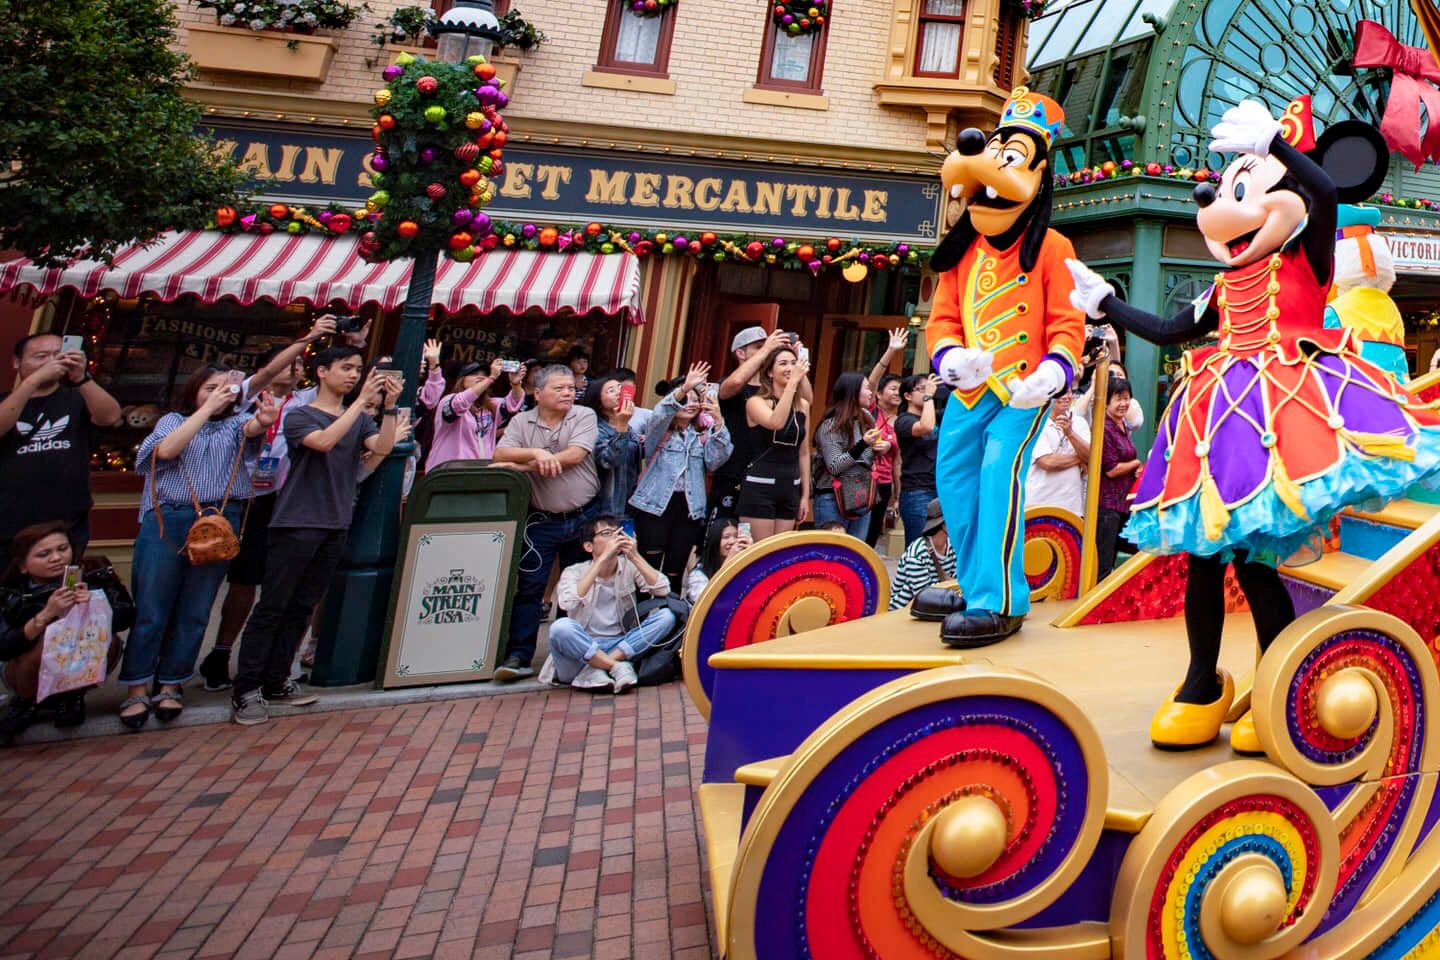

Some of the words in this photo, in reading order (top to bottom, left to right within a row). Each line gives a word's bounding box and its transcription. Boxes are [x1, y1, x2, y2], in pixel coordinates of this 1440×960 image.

[584, 168, 889, 224] MERCANTILE
[138, 314, 241, 346] FASHIONS
[435, 324, 497, 345] GOODS
[184, 343, 199, 357] &
[16, 439, 72, 455] adidas
[432, 584, 475, 594] MAIN
[418, 593, 482, 619] STREET
[434, 611, 464, 624] USA
